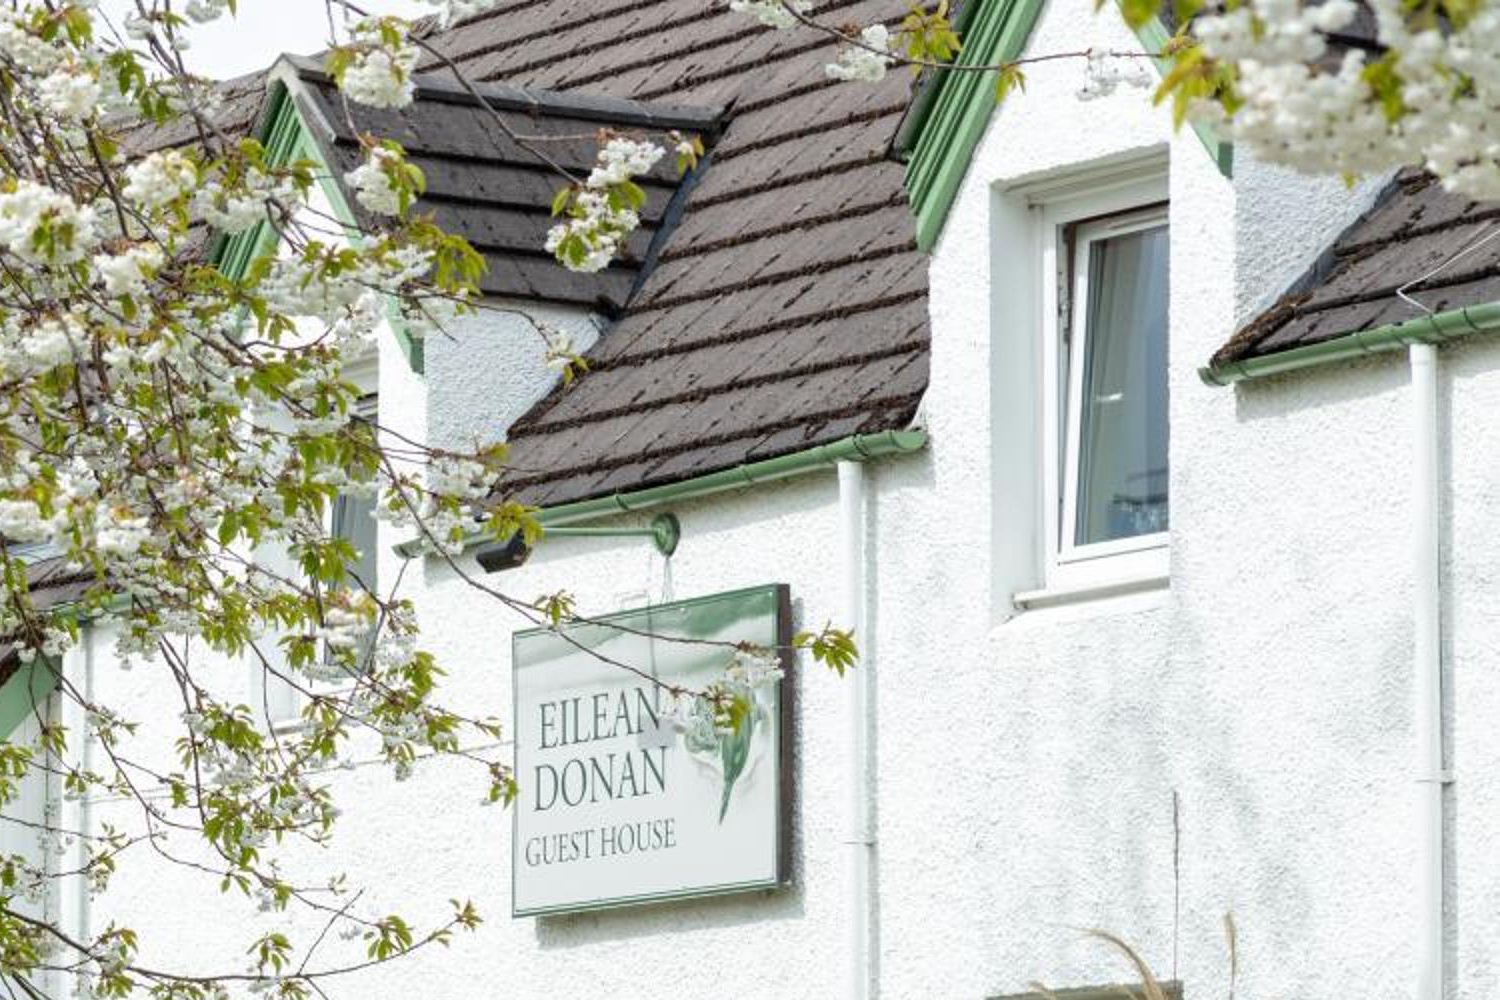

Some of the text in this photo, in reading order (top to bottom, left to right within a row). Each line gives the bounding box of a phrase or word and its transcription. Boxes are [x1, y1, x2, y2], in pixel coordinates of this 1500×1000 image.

[539, 686, 661, 748] EILEAN
[534, 746, 667, 811] DONAN
[525, 818, 676, 867] GUEST HOUSE
